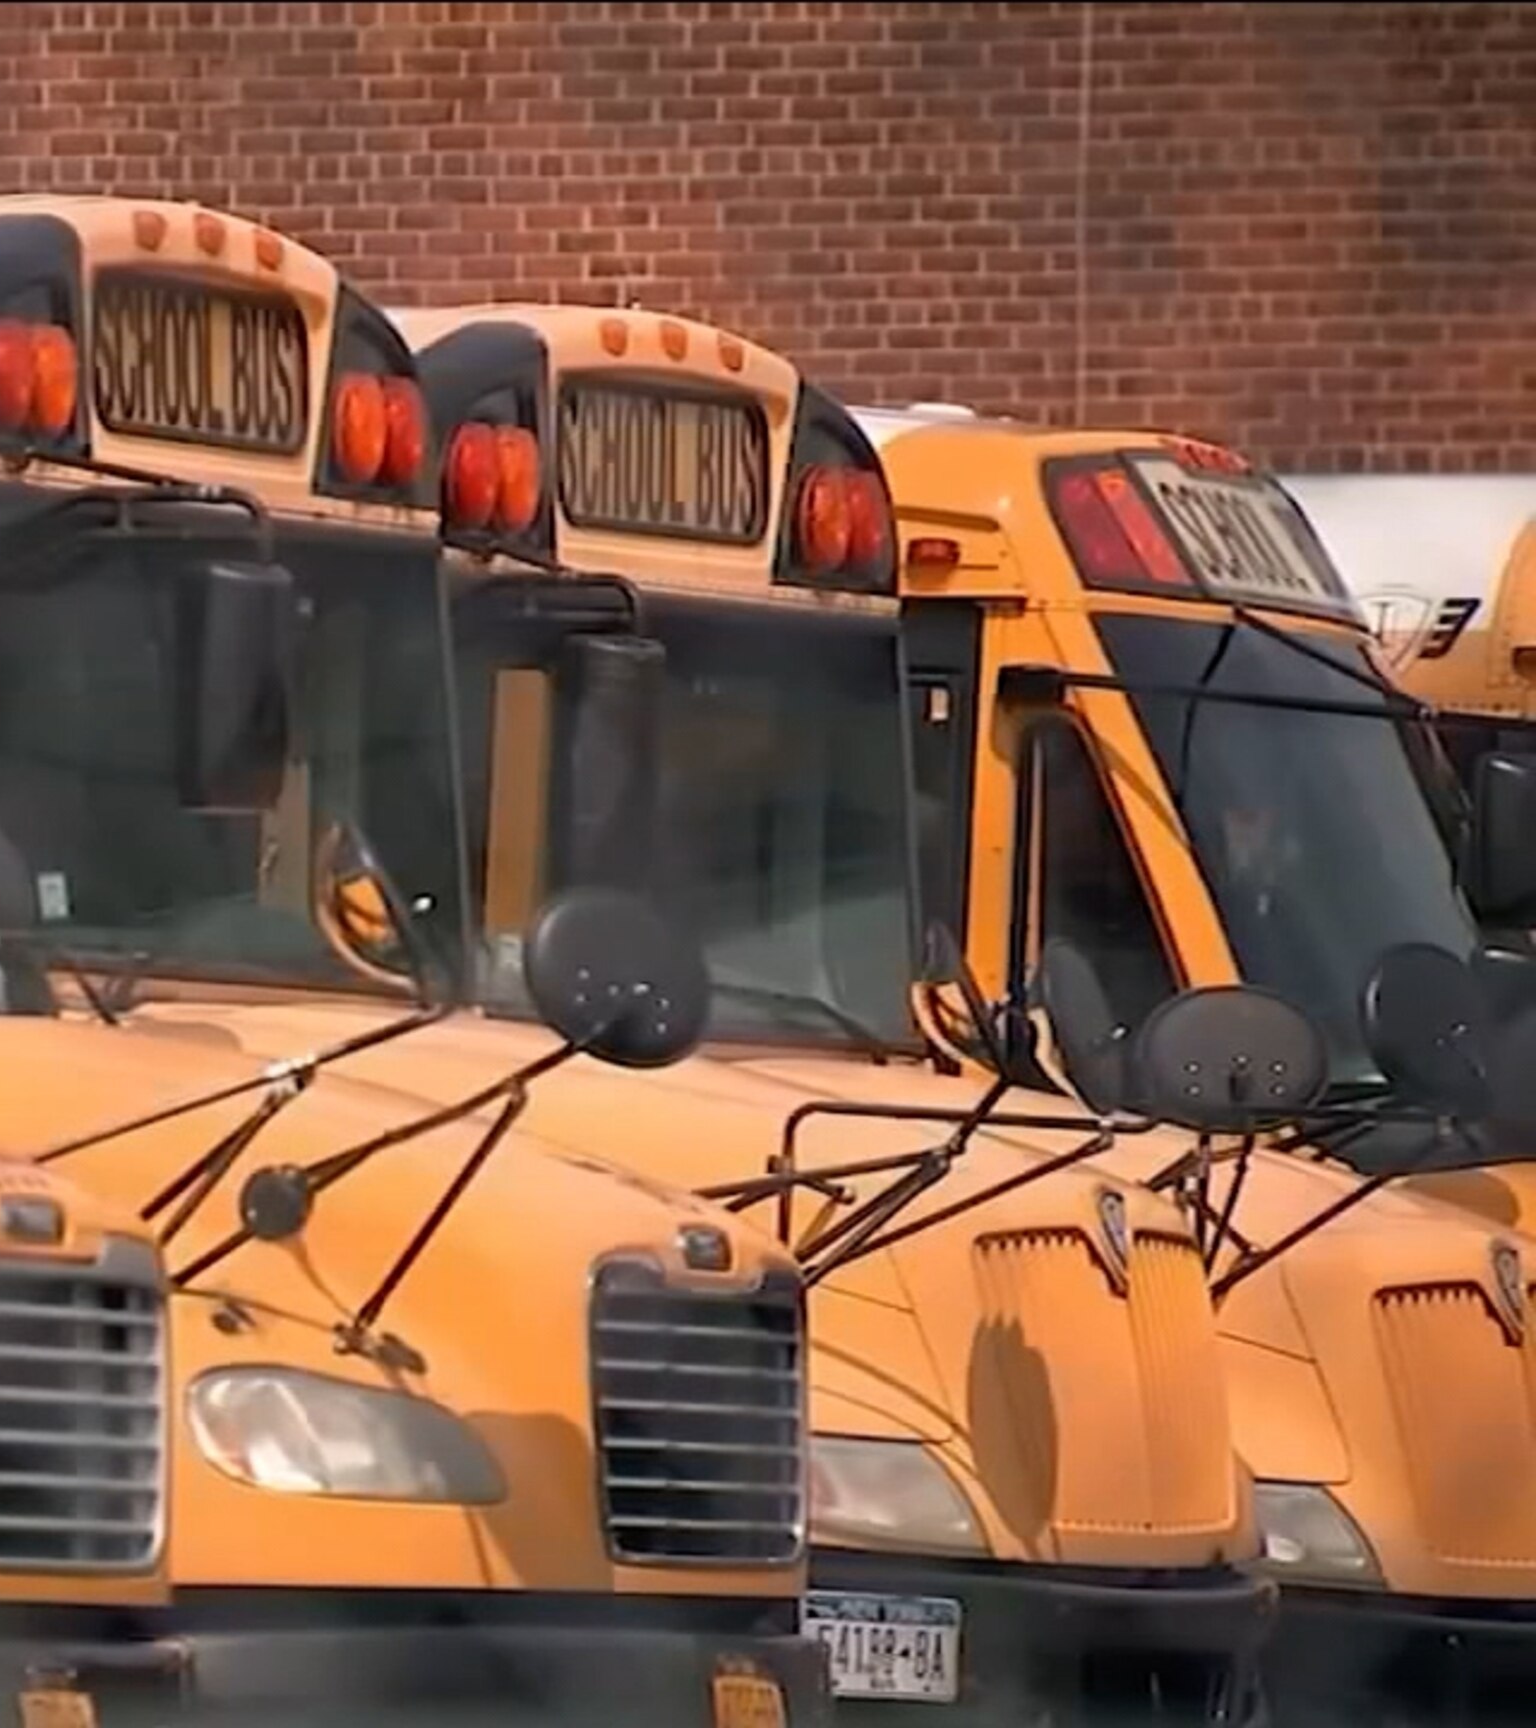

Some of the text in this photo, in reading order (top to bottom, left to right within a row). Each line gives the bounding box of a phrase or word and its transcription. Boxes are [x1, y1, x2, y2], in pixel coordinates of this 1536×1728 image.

[93, 284, 294, 444] SCHOOL BUS
[558, 386, 759, 536] SCHOOL BUS
